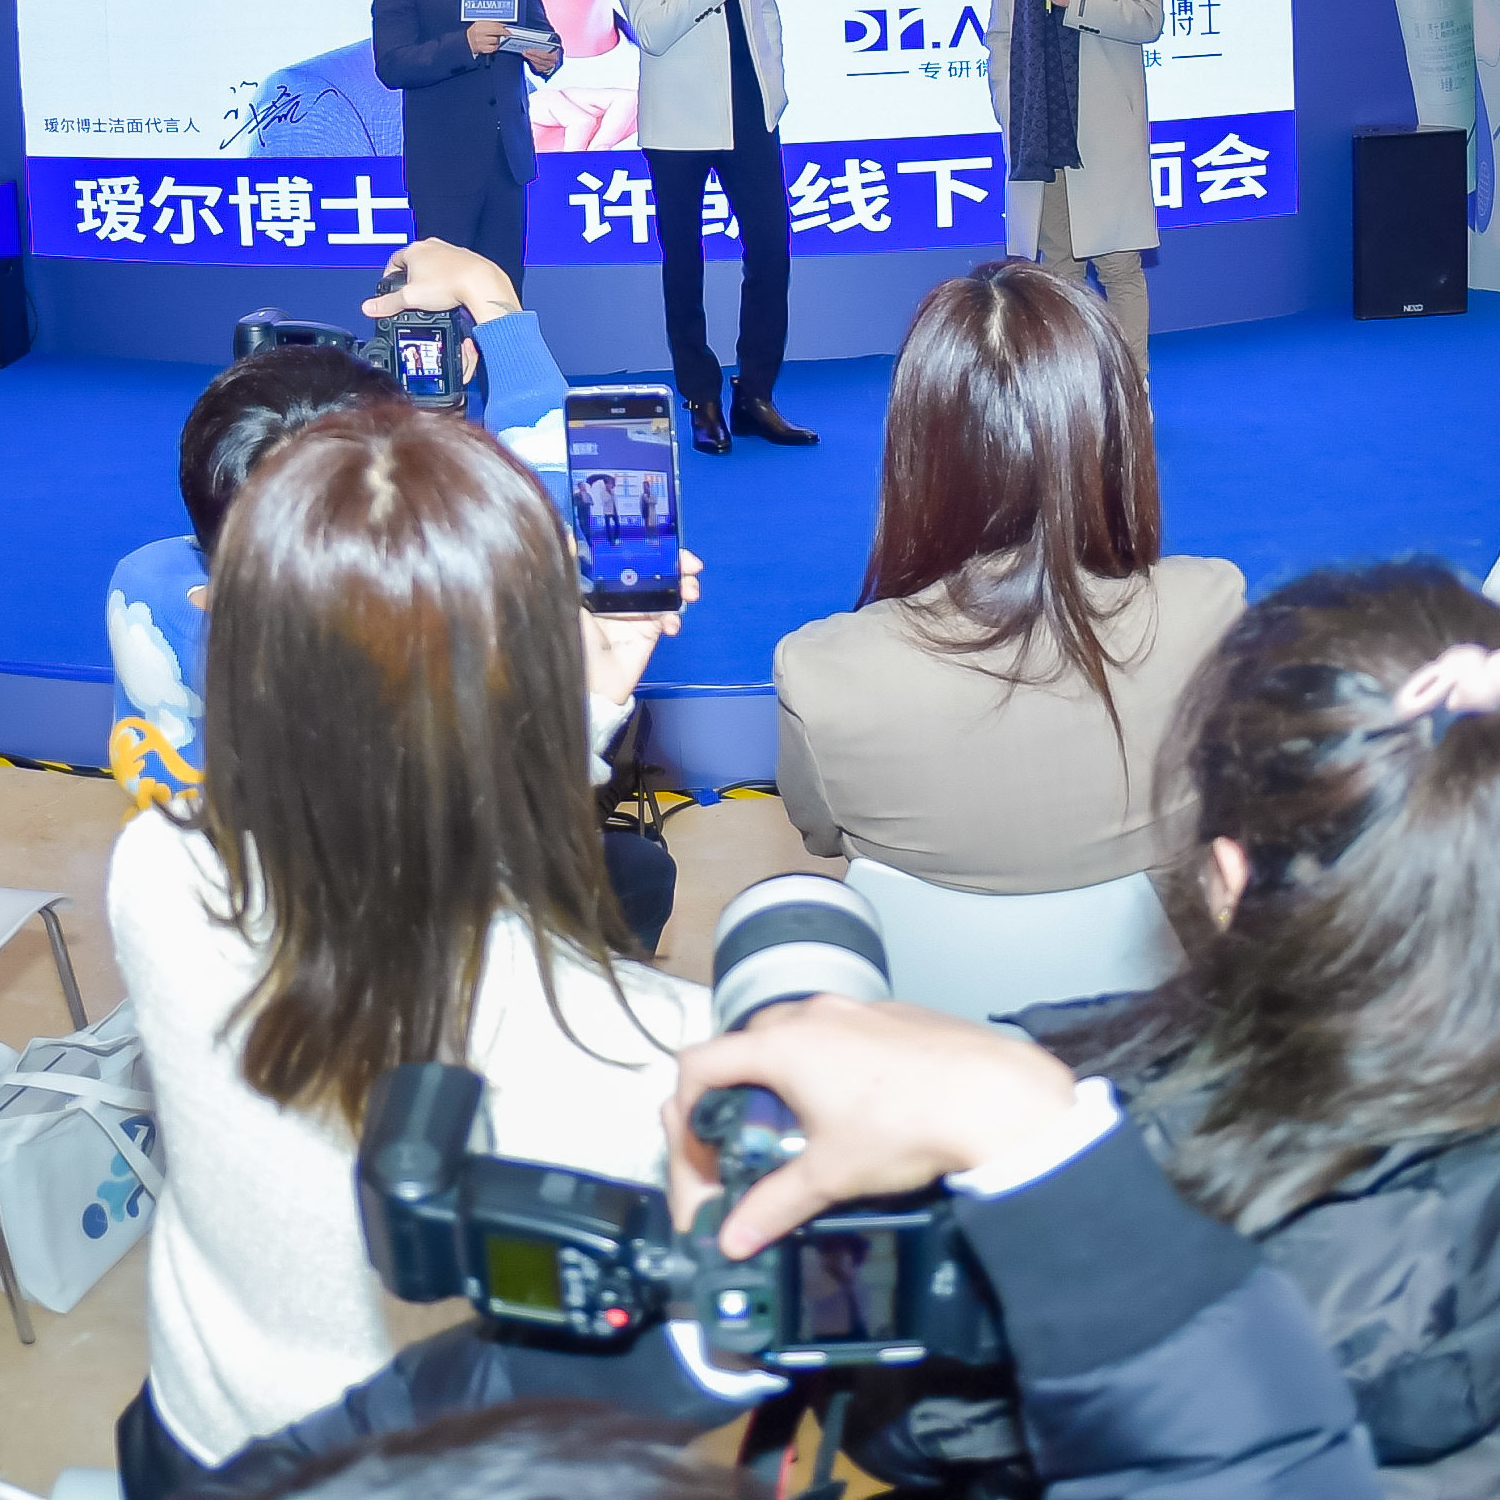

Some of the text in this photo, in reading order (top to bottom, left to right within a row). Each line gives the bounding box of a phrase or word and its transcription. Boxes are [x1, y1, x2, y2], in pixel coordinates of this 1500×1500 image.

[43, 117, 201, 135] 瑷尔博士洁面代言人
[74, 174, 411, 247] 瑷尔博士
